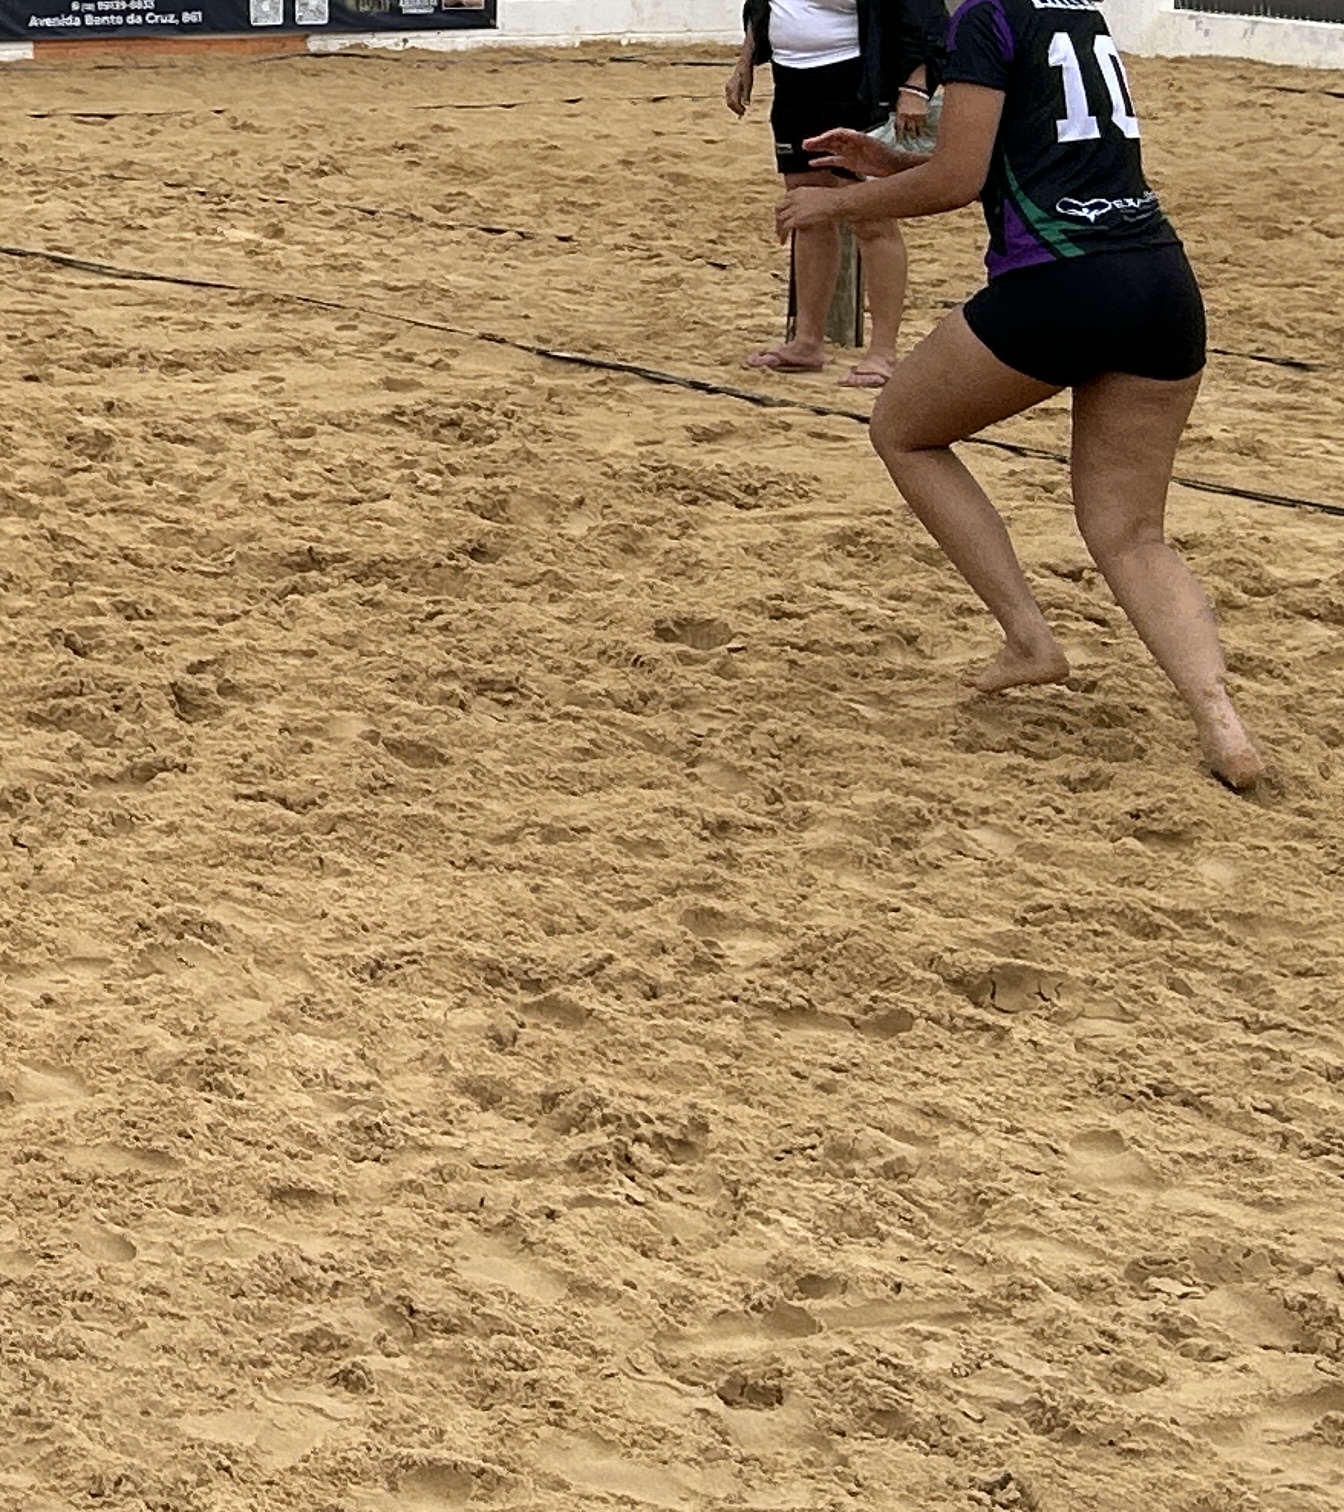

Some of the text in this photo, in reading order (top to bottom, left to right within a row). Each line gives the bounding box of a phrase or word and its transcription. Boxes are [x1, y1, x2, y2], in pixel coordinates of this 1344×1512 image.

[27, 13, 82, 28] Avenida
[126, 12, 143, 25] da
[144, 11, 180, 26] Cruz,
